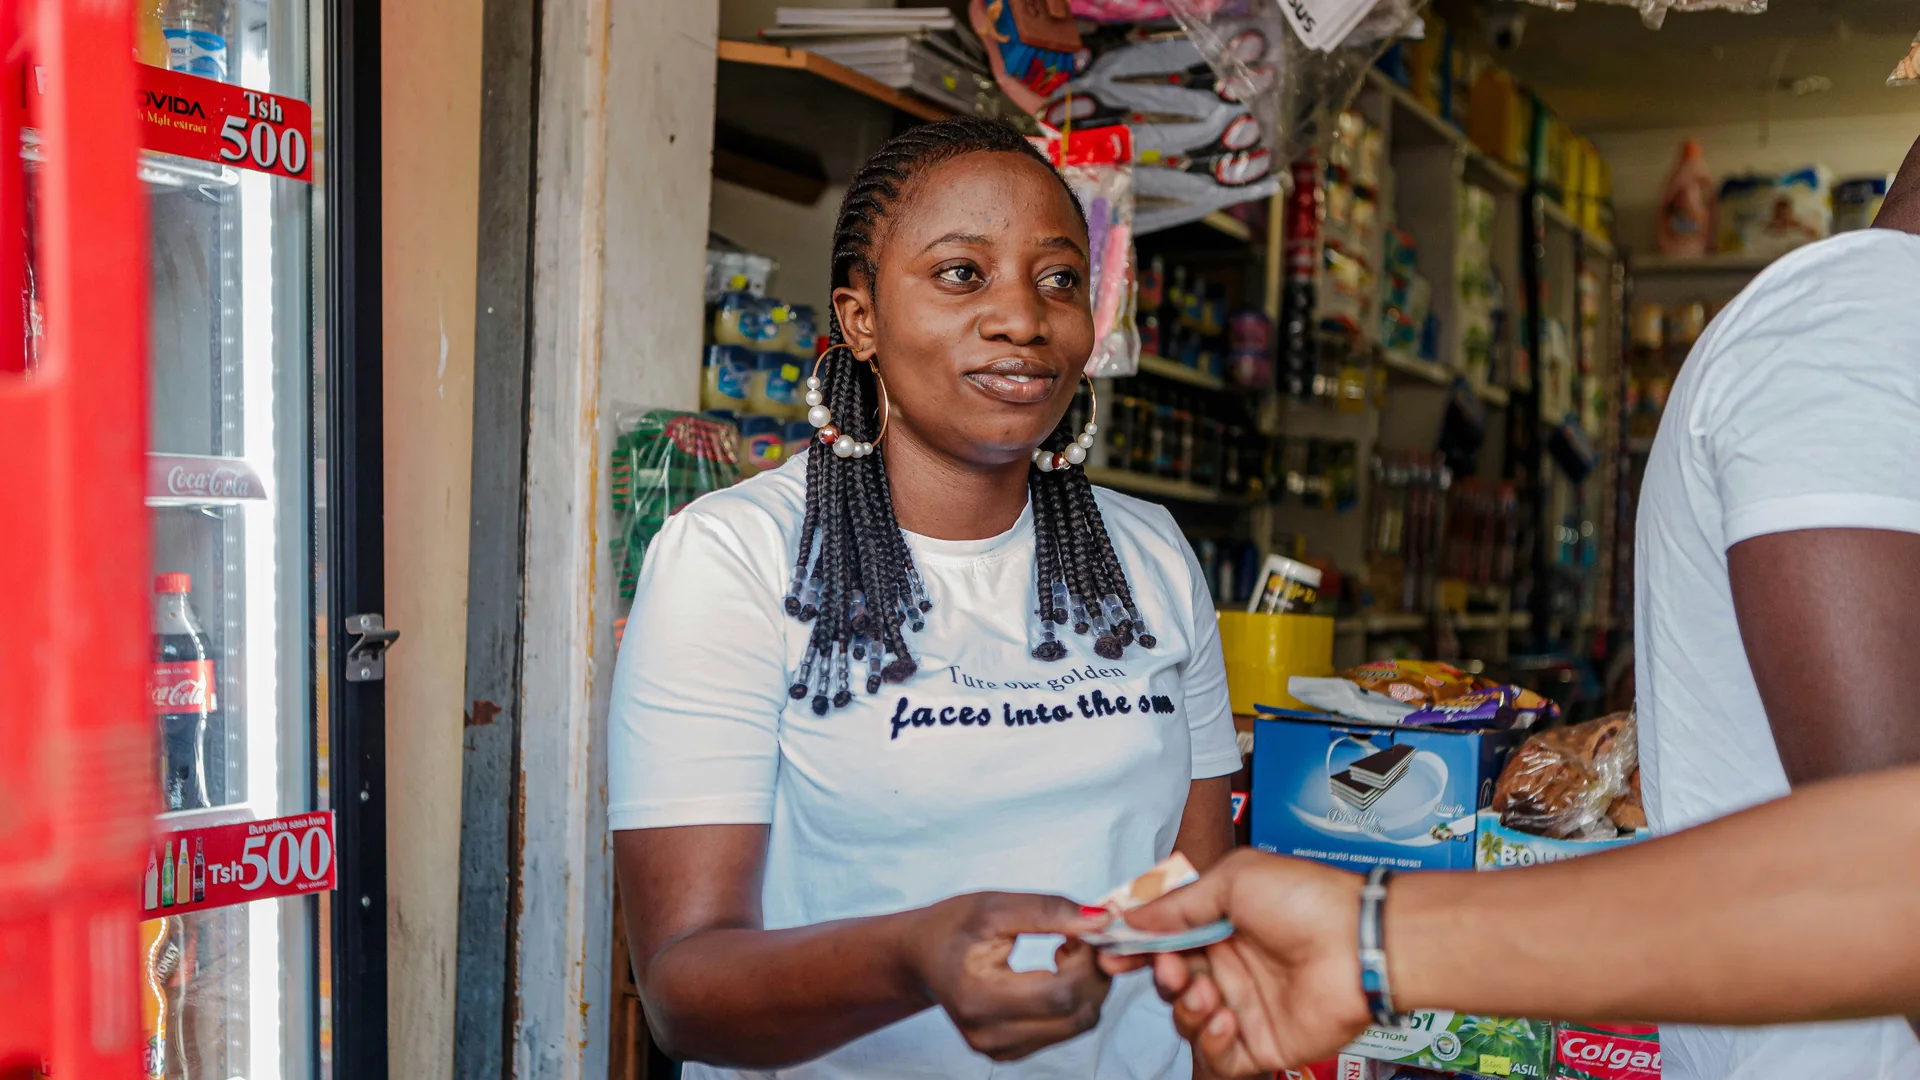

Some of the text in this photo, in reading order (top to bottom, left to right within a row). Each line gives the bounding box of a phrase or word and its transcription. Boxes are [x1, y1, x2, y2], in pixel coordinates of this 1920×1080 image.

[137, 88, 206, 120] OVIDA
[243, 91, 283, 123] Tsh
[147, 110, 171, 127] Malt
[173, 120, 207, 134] extract
[220, 114, 307, 174] 500
[1046, 665, 1127, 692] golden
[890, 697, 991, 740] faces
[1002, 702, 1073, 727] into
[1076, 689, 1132, 719] the
[208, 827, 331, 891] Tsh 500
[1361, 1028, 1408, 1043] TECTION
[1563, 1038, 1661, 1069] Colgat
[1510, 1063, 1540, 1077] ASIL
